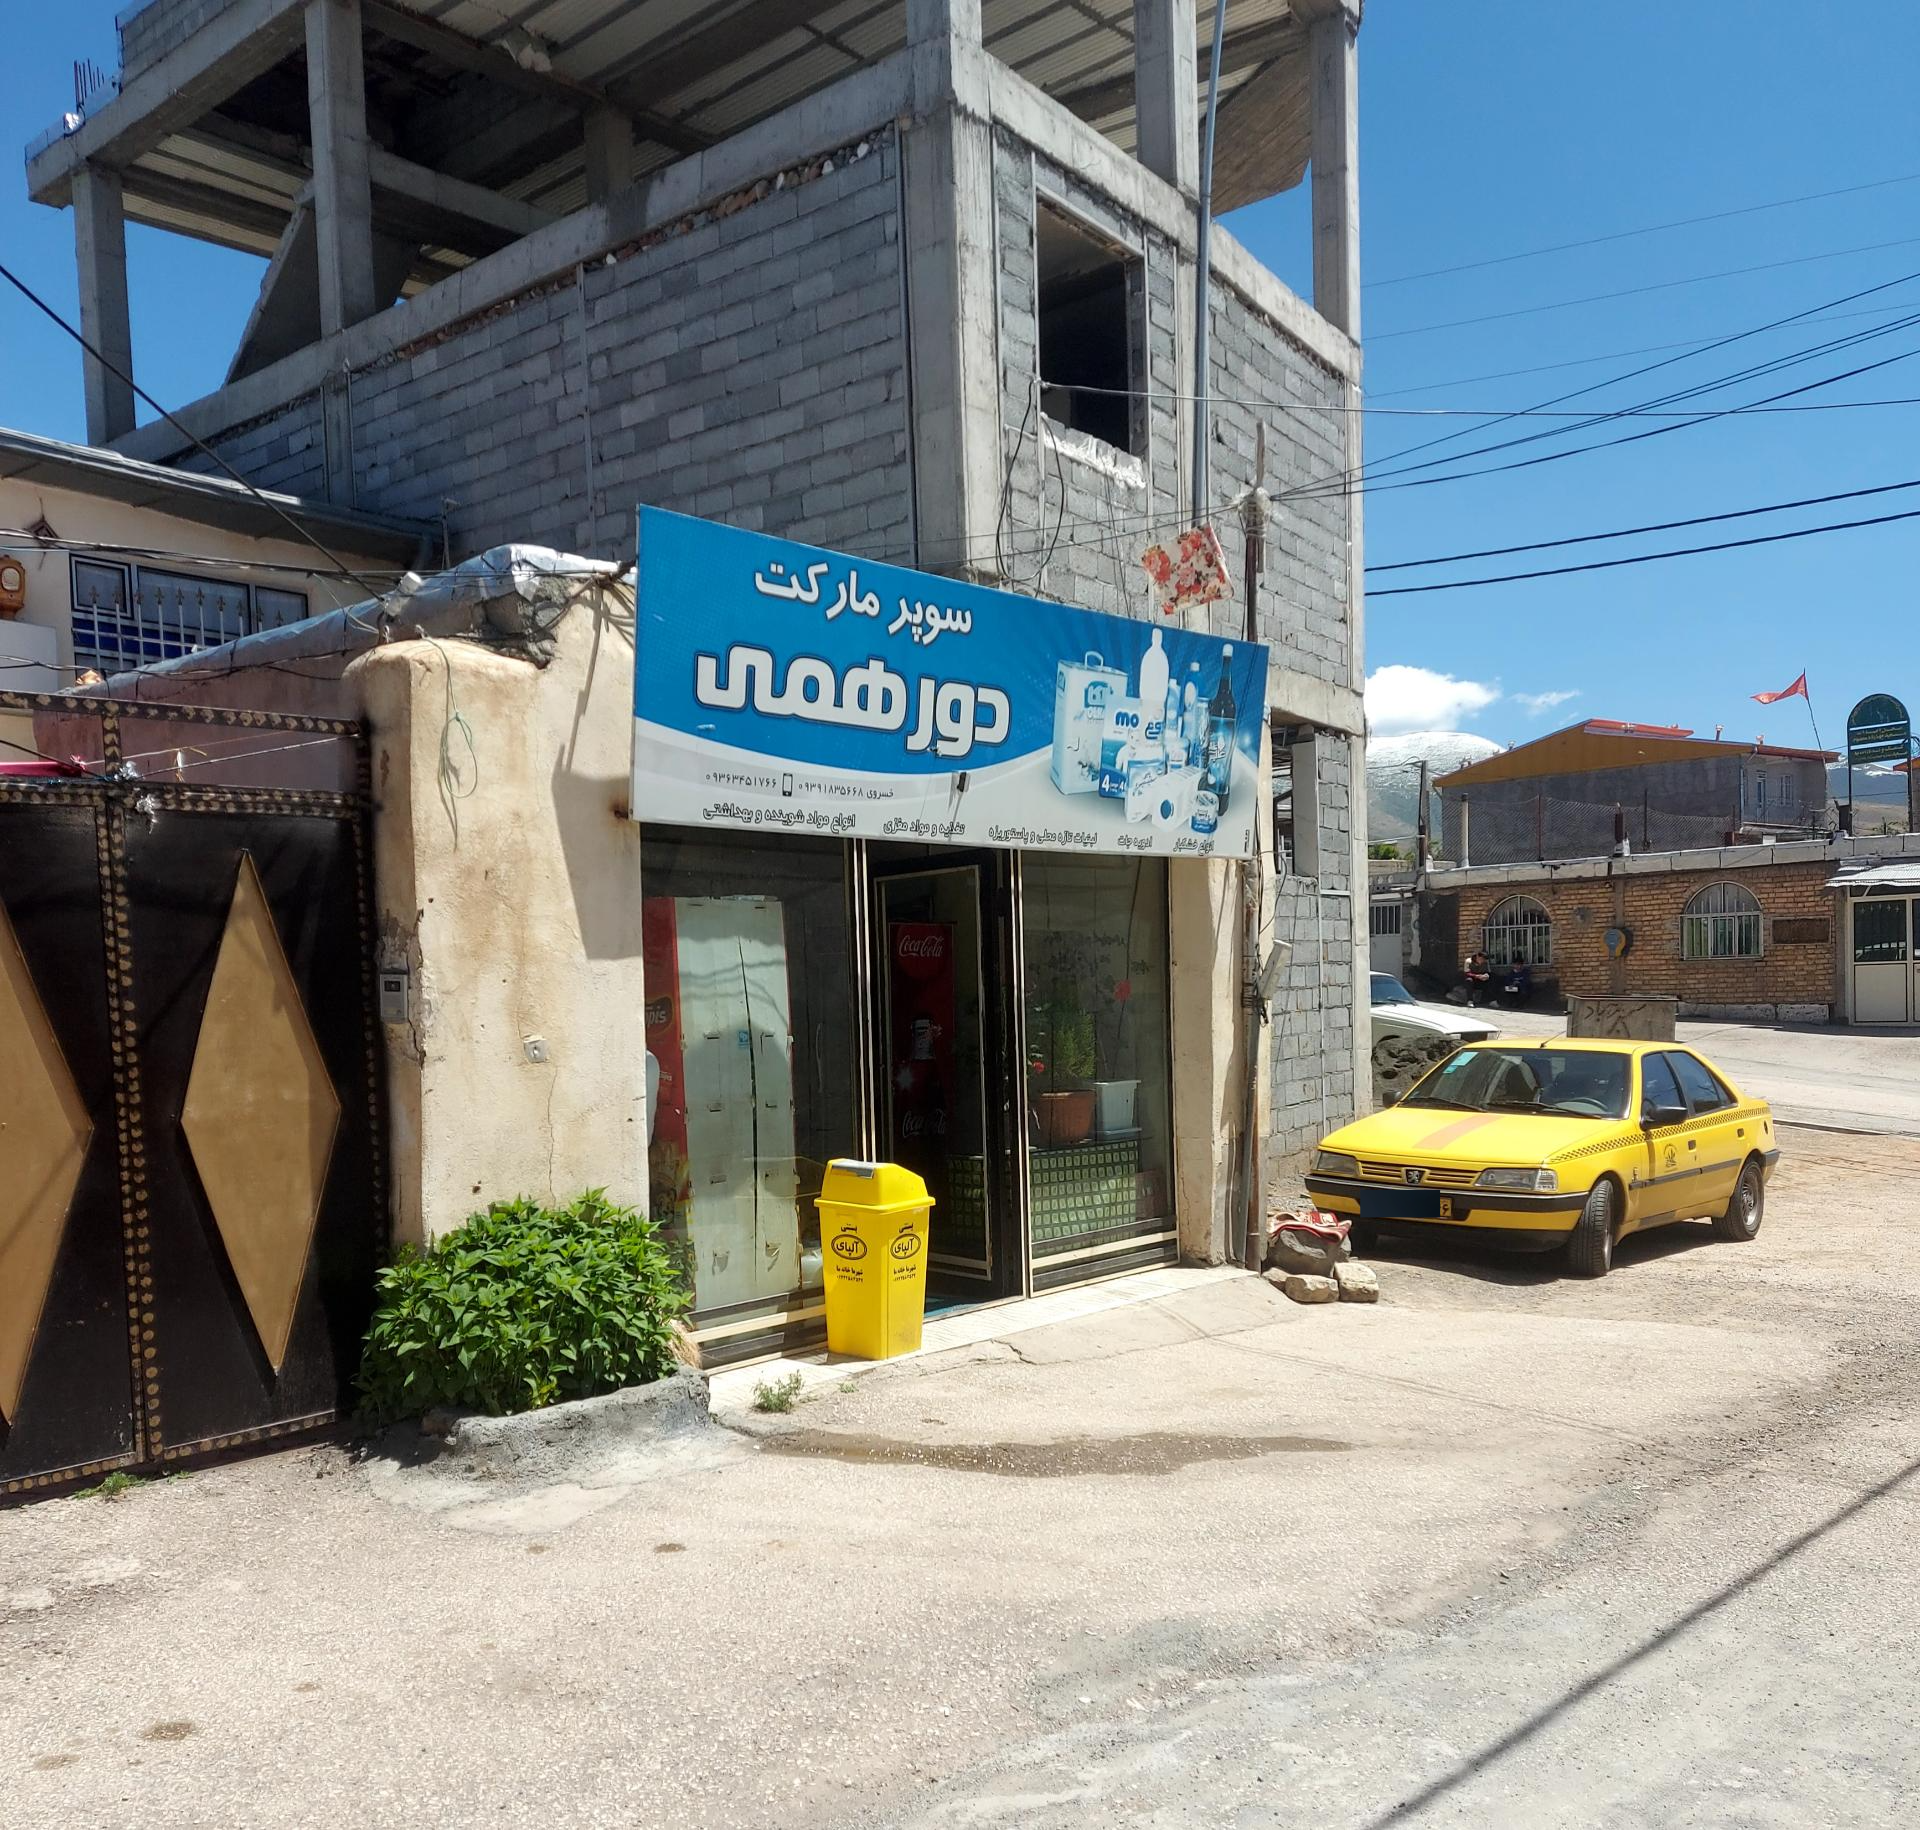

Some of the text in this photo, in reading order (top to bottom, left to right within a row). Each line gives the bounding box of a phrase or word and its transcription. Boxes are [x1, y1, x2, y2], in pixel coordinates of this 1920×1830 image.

[755, 562, 972, 645] سوپر مارکت
[1101, 774, 1110, 792] 4
[866, 788, 894, 799] خسروی
[703, 803, 856, 834] انواع مواد شوینده و بهداشتی
[910, 819, 930, 836] مواد
[931, 824, 937, 837] و
[989, 825, 1097, 847] لبنیات تازه محلی و پاستوریزه
